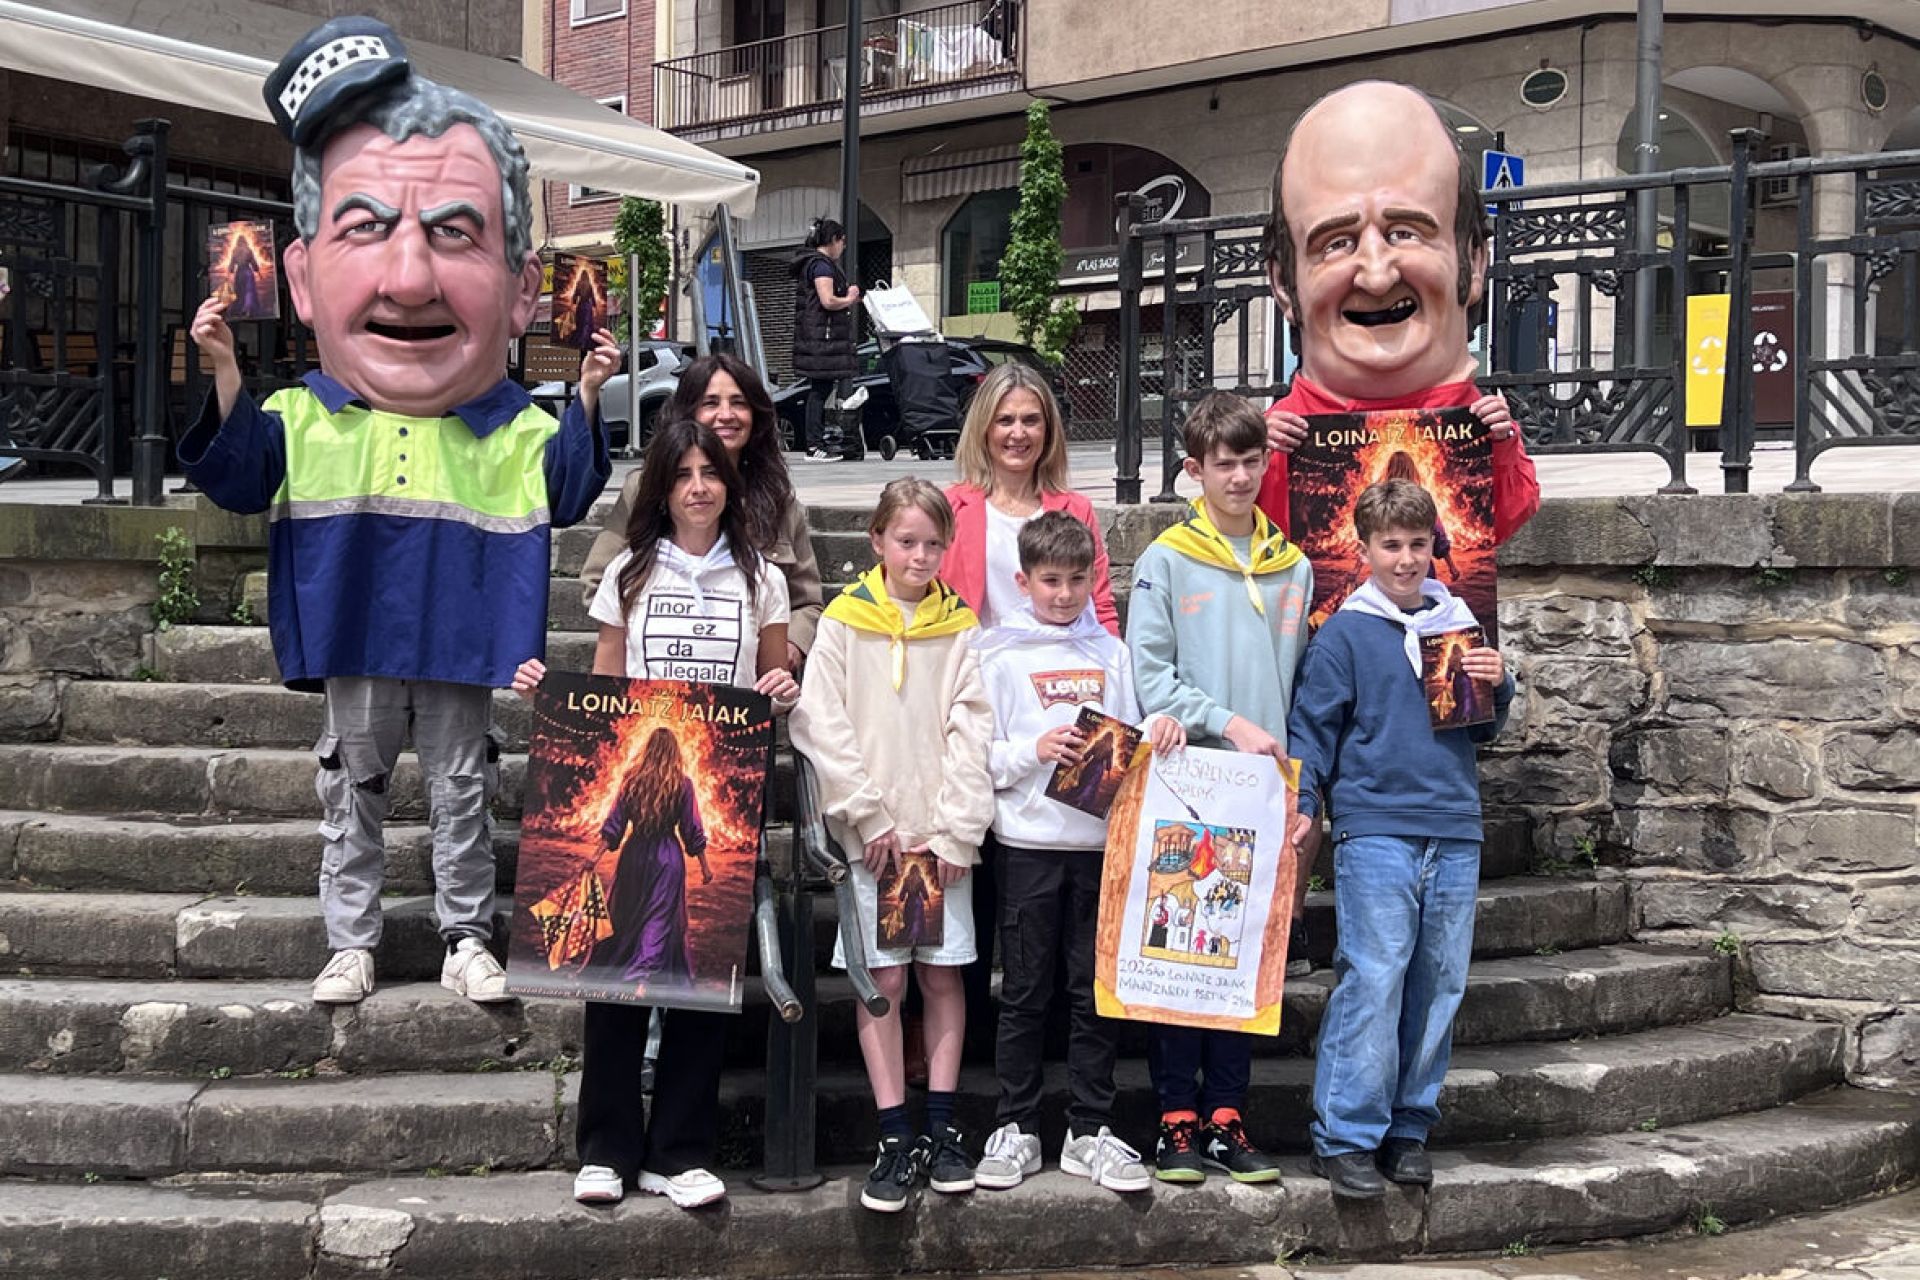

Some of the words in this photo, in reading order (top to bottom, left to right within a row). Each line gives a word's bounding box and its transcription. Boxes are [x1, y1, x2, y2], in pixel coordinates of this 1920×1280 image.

[1315, 427, 1405, 447] LOINATZ
[1414, 422, 1474, 443] JAIAK
[654, 599, 696, 615] inor
[692, 623, 717, 636] ez
[666, 638, 693, 657] da
[662, 660, 729, 682] ilegala
[567, 692, 675, 720] LOINATZ
[679, 702, 750, 726] JAIAK
